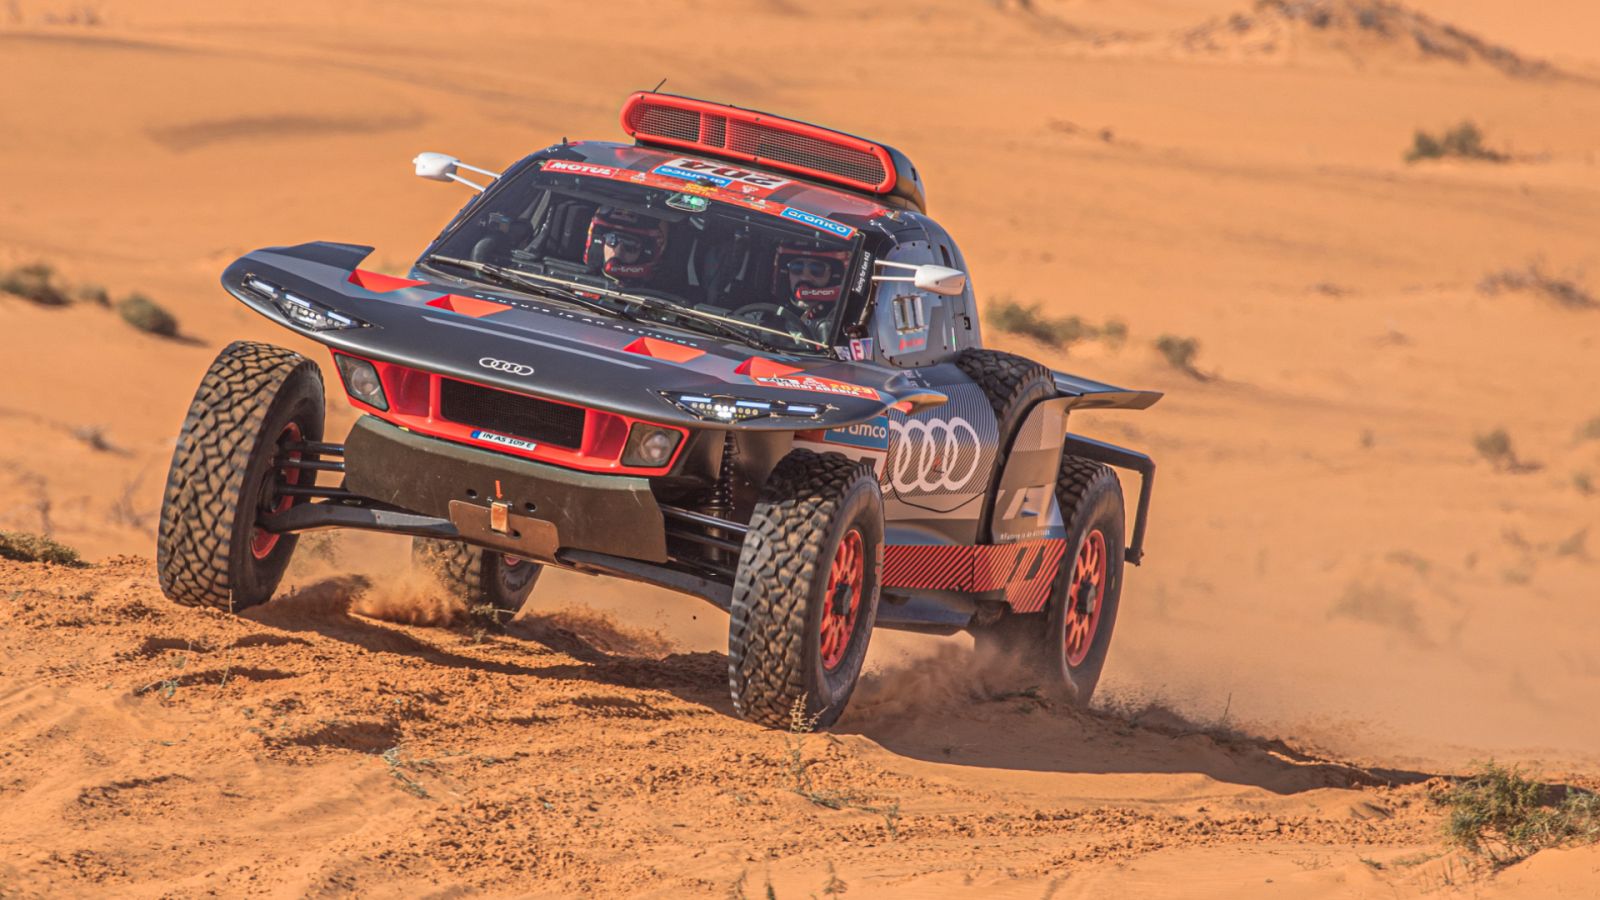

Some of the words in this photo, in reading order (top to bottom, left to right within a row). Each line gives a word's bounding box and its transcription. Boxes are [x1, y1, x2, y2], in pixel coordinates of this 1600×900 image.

[550, 161, 612, 175] MOTUL
[679, 159, 777, 185] 204
[787, 210, 849, 234] aramco
[855, 277, 866, 293] Racing
[852, 342, 862, 360] E
[830, 383, 873, 394] 2023
